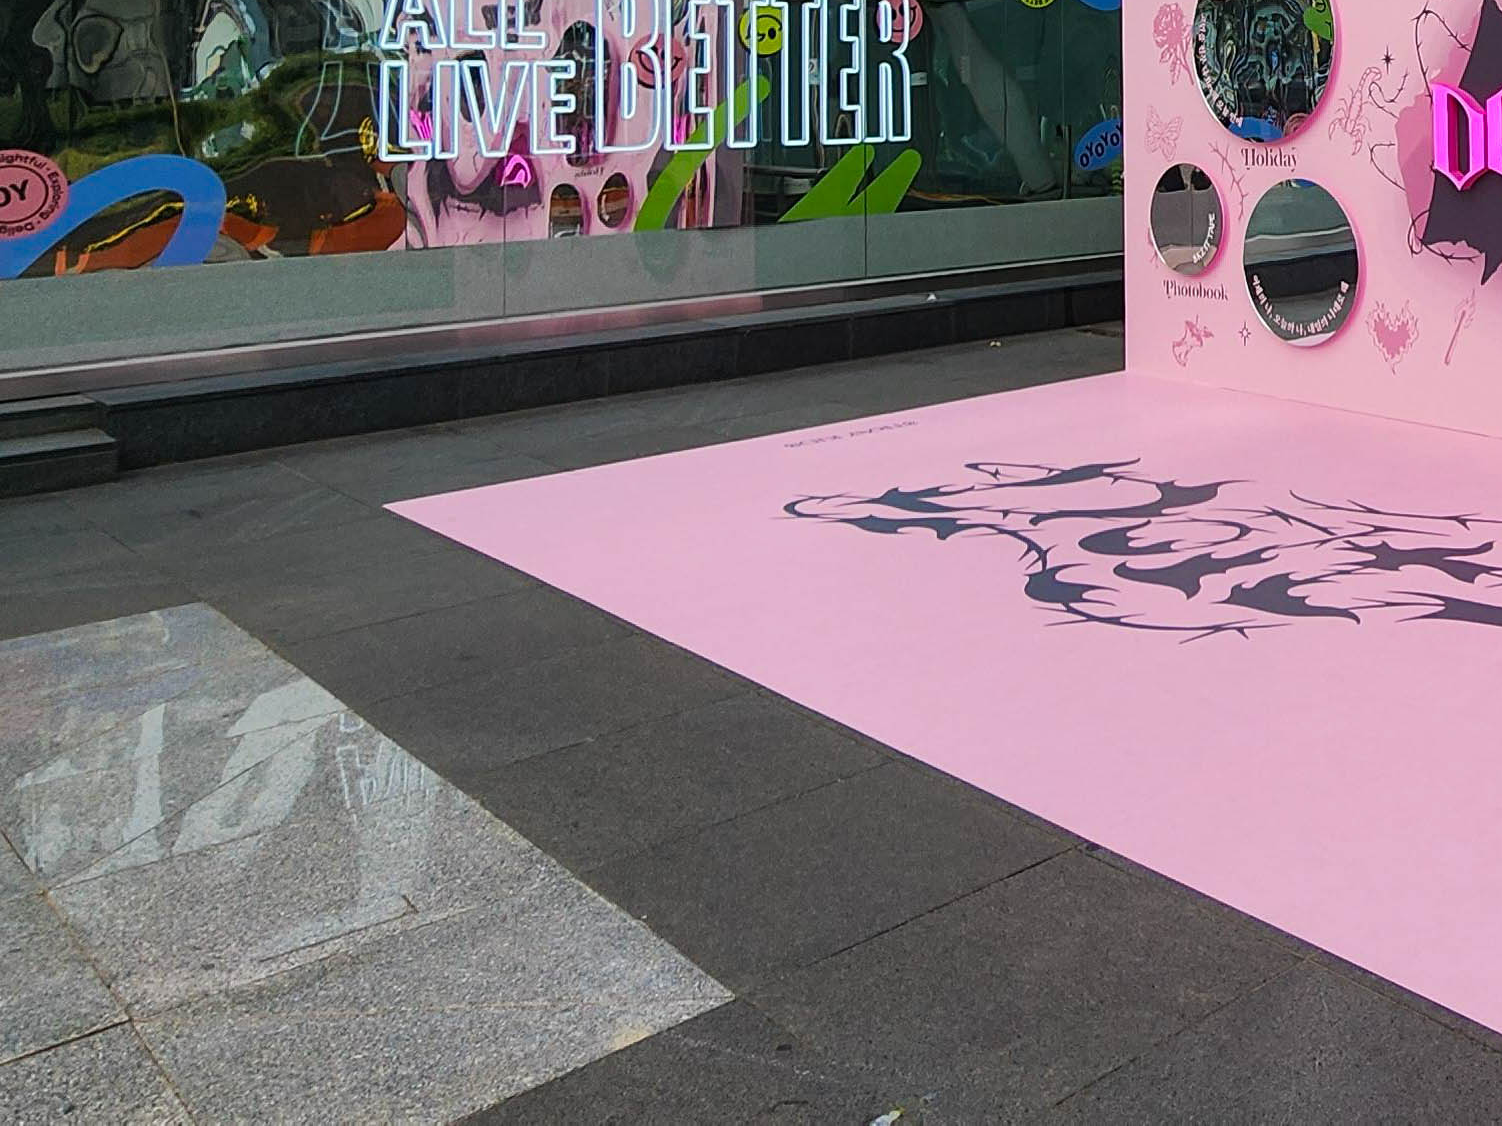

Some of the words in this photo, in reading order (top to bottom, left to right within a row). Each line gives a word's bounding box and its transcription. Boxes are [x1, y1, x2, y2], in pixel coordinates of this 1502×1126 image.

[378, 59, 577, 162] LIVE
[1241, 146, 1297, 172] Holiday
[1163, 279, 1228, 301] Photobook
